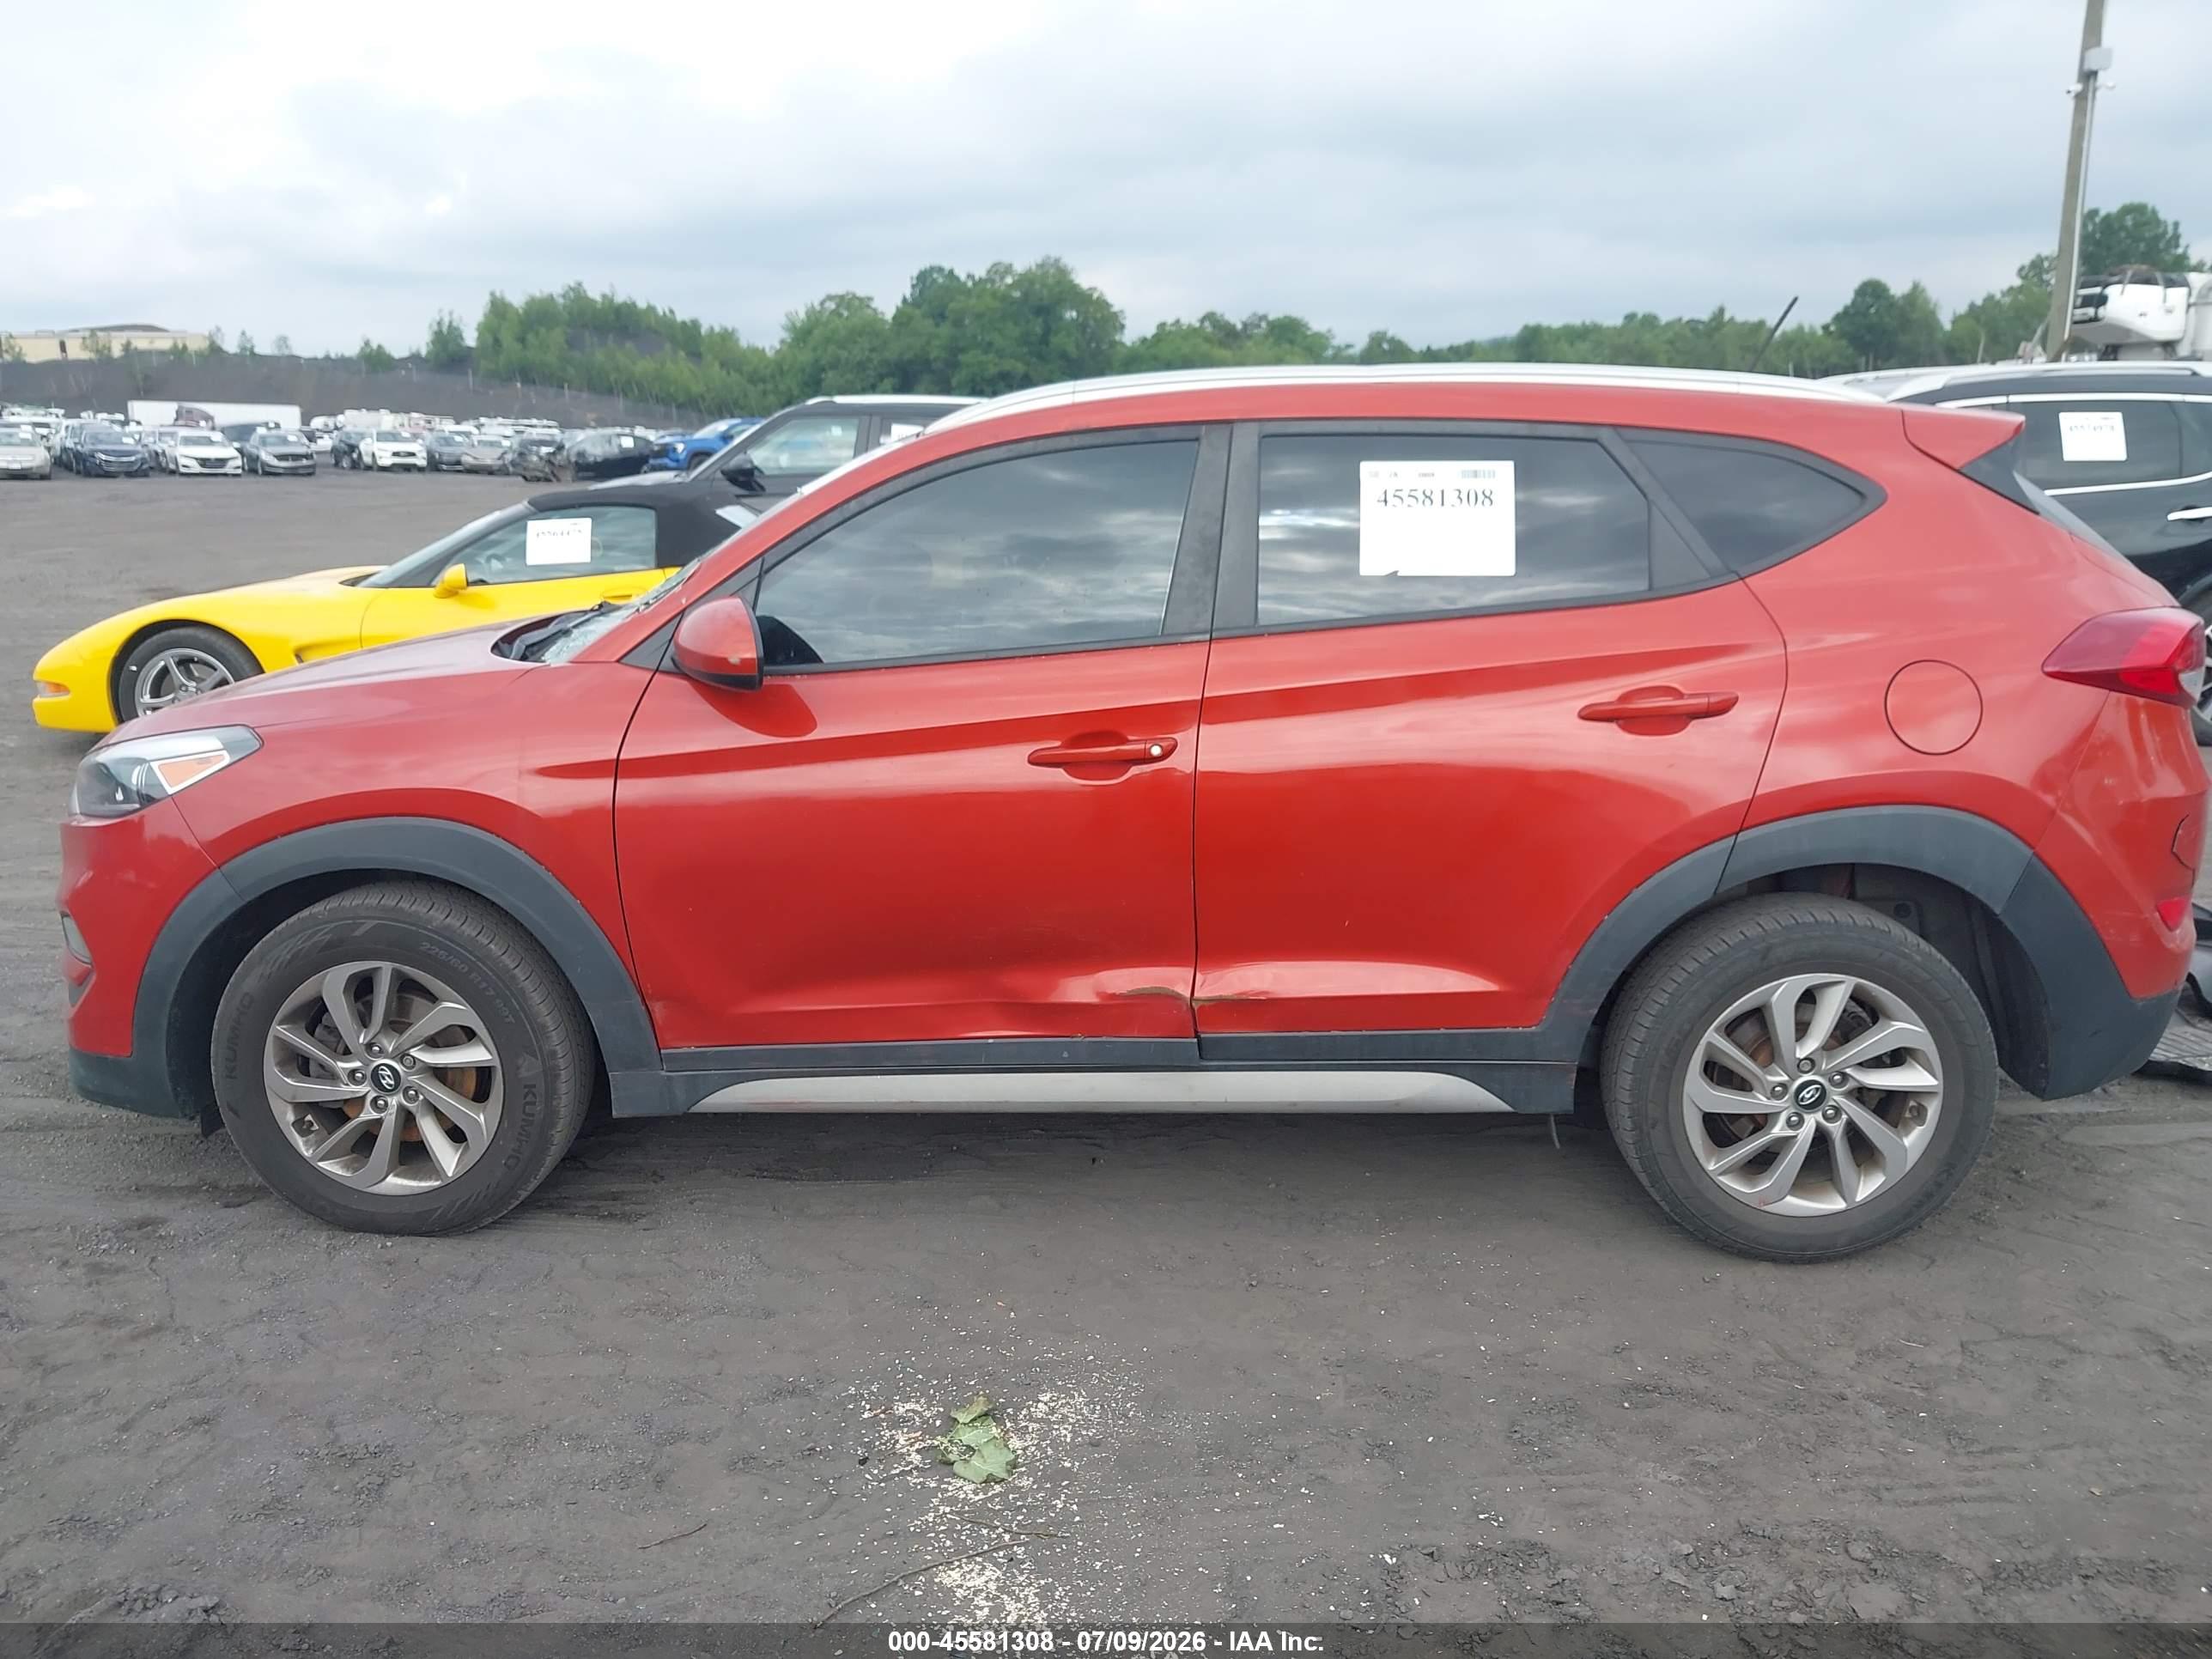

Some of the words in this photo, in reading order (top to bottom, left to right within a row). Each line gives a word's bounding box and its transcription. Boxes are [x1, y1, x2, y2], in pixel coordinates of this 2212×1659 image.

[1376, 488, 1494, 507] 45581308
[226, 991, 254, 1080] KUMHO
[503, 1083, 538, 1170] KUMHO
